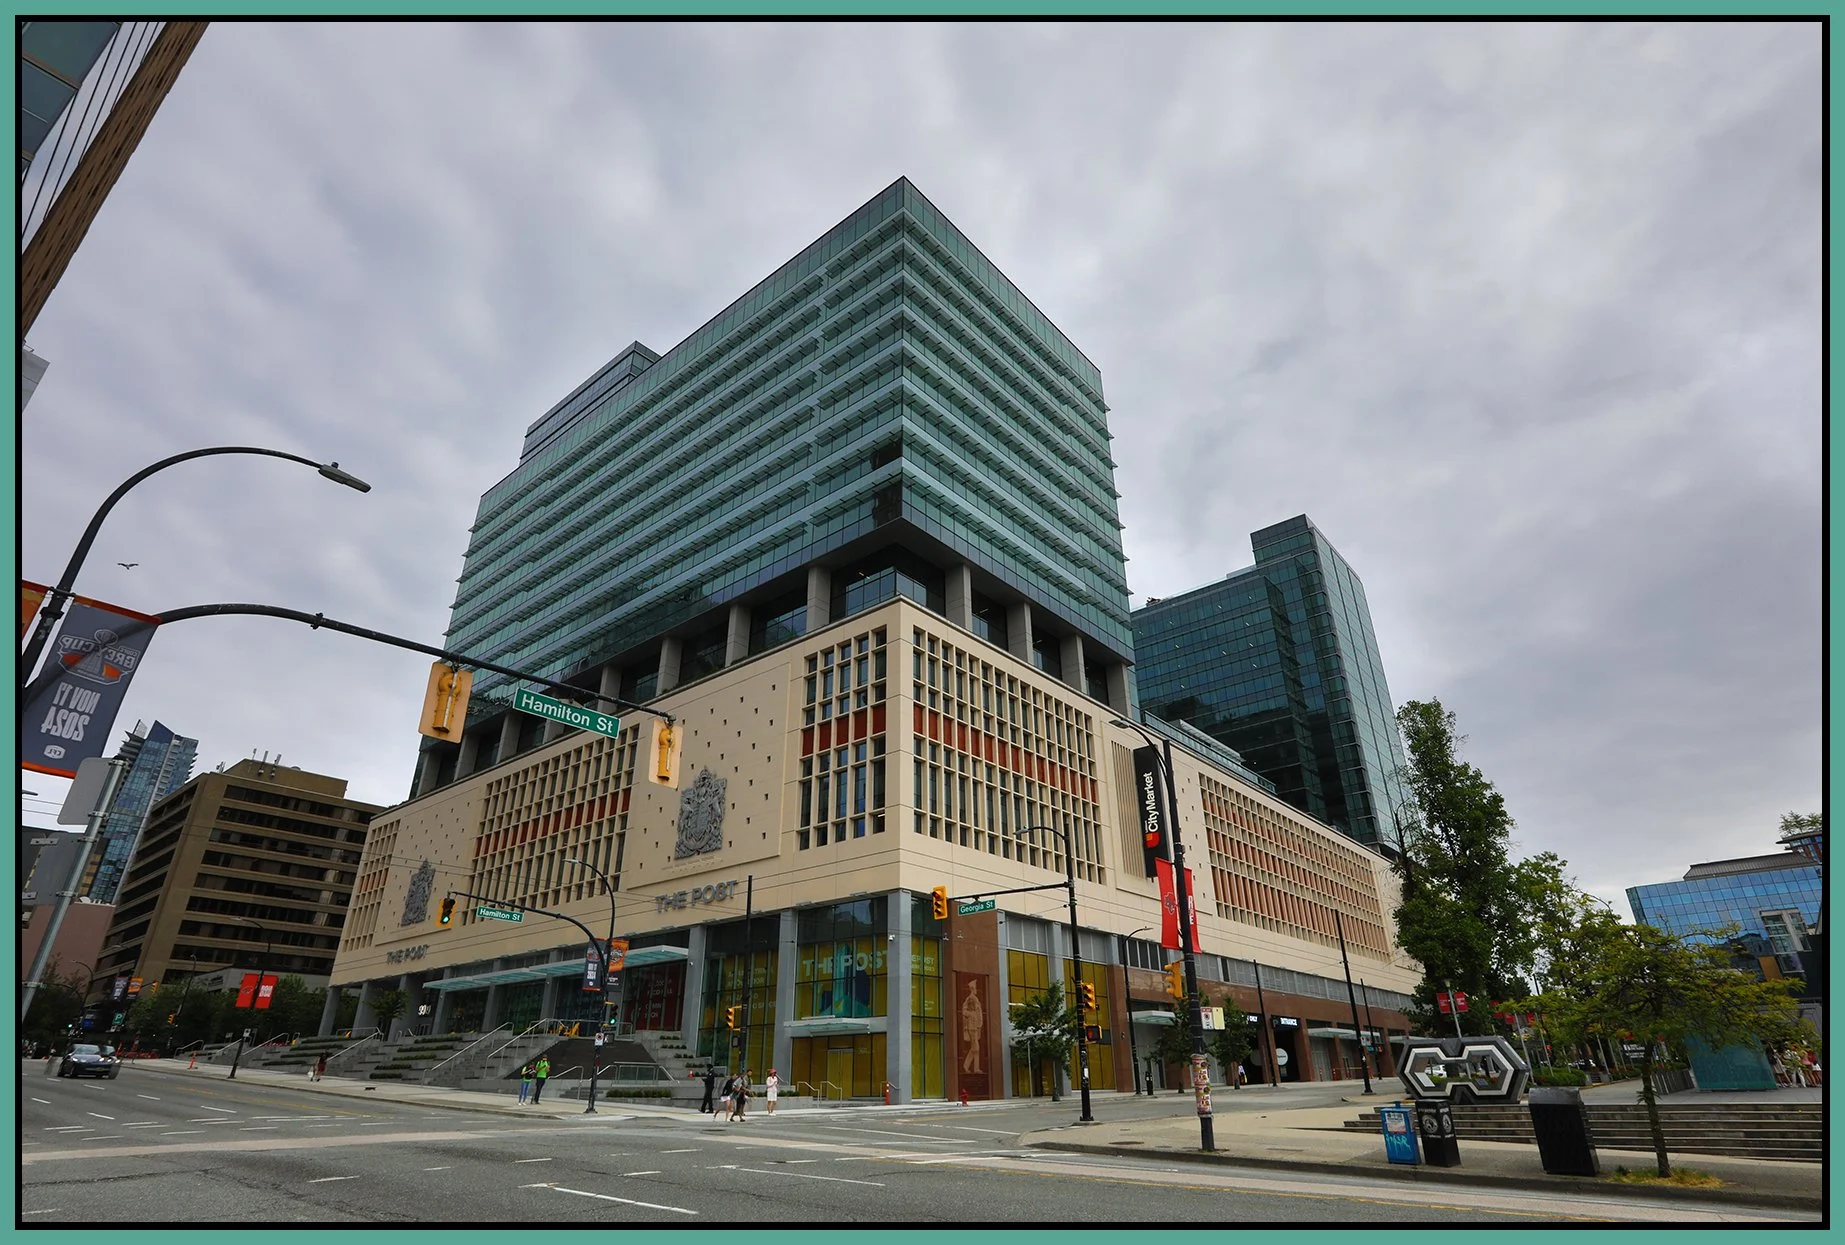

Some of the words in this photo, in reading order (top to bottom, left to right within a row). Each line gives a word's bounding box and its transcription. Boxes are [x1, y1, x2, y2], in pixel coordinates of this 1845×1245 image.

[521, 693, 590, 727] Hamilton
[596, 716, 613, 733] St
[655, 889, 688, 914] THE
[692, 879, 738, 907] POST
[960, 903, 984, 914] Georgia
[986, 901, 994, 909] St
[479, 908, 510, 920] Hamilton
